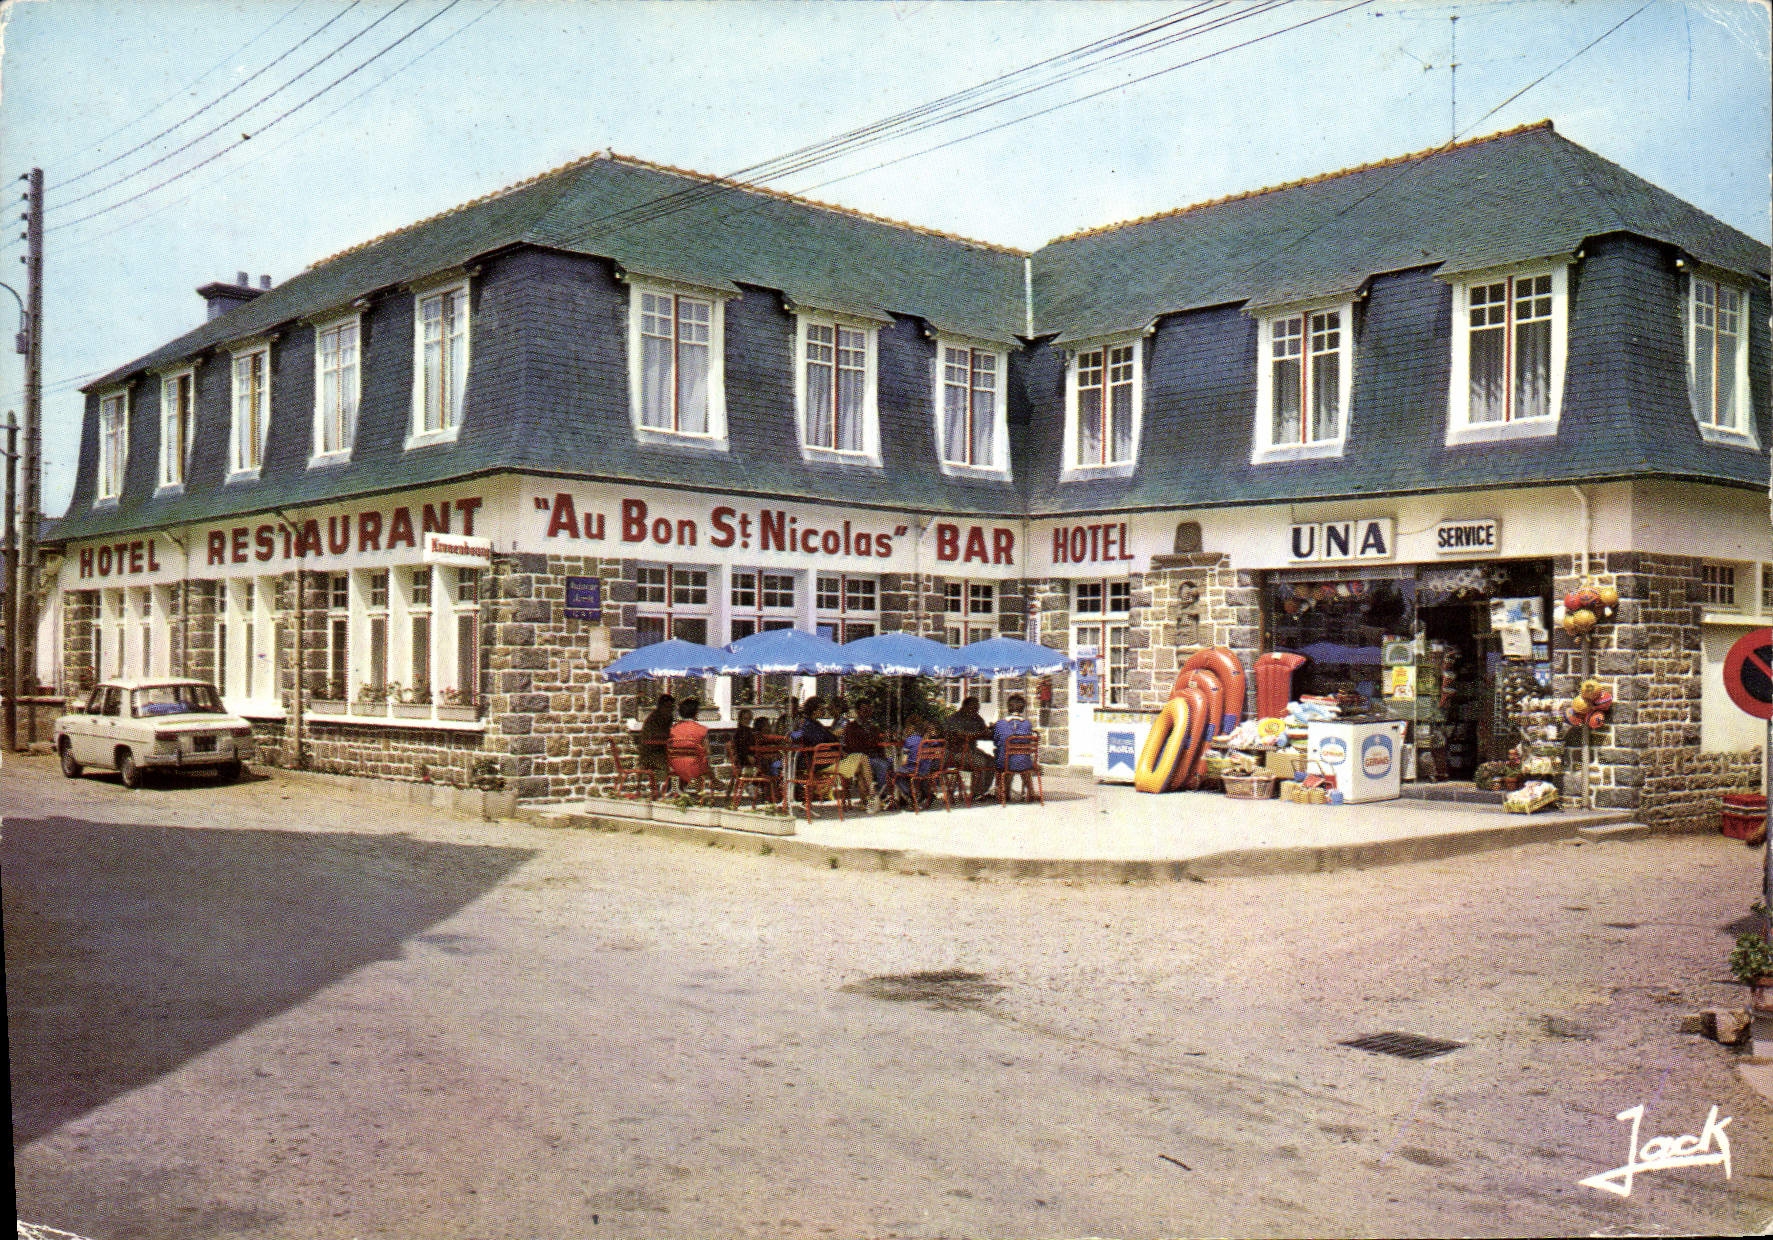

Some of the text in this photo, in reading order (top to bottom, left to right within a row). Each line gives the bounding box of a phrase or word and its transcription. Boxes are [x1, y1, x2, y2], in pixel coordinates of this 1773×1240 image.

[207, 497, 482, 566] RESTAURANT
[621, 498, 698, 546] Bon
[1292, 522, 1388, 560] UNA
[1438, 524, 1494, 548] SERVICE
[79, 539, 160, 579] HOTEL
[936, 522, 1015, 565] BAR
[1053, 523, 1134, 563] HOTEL
